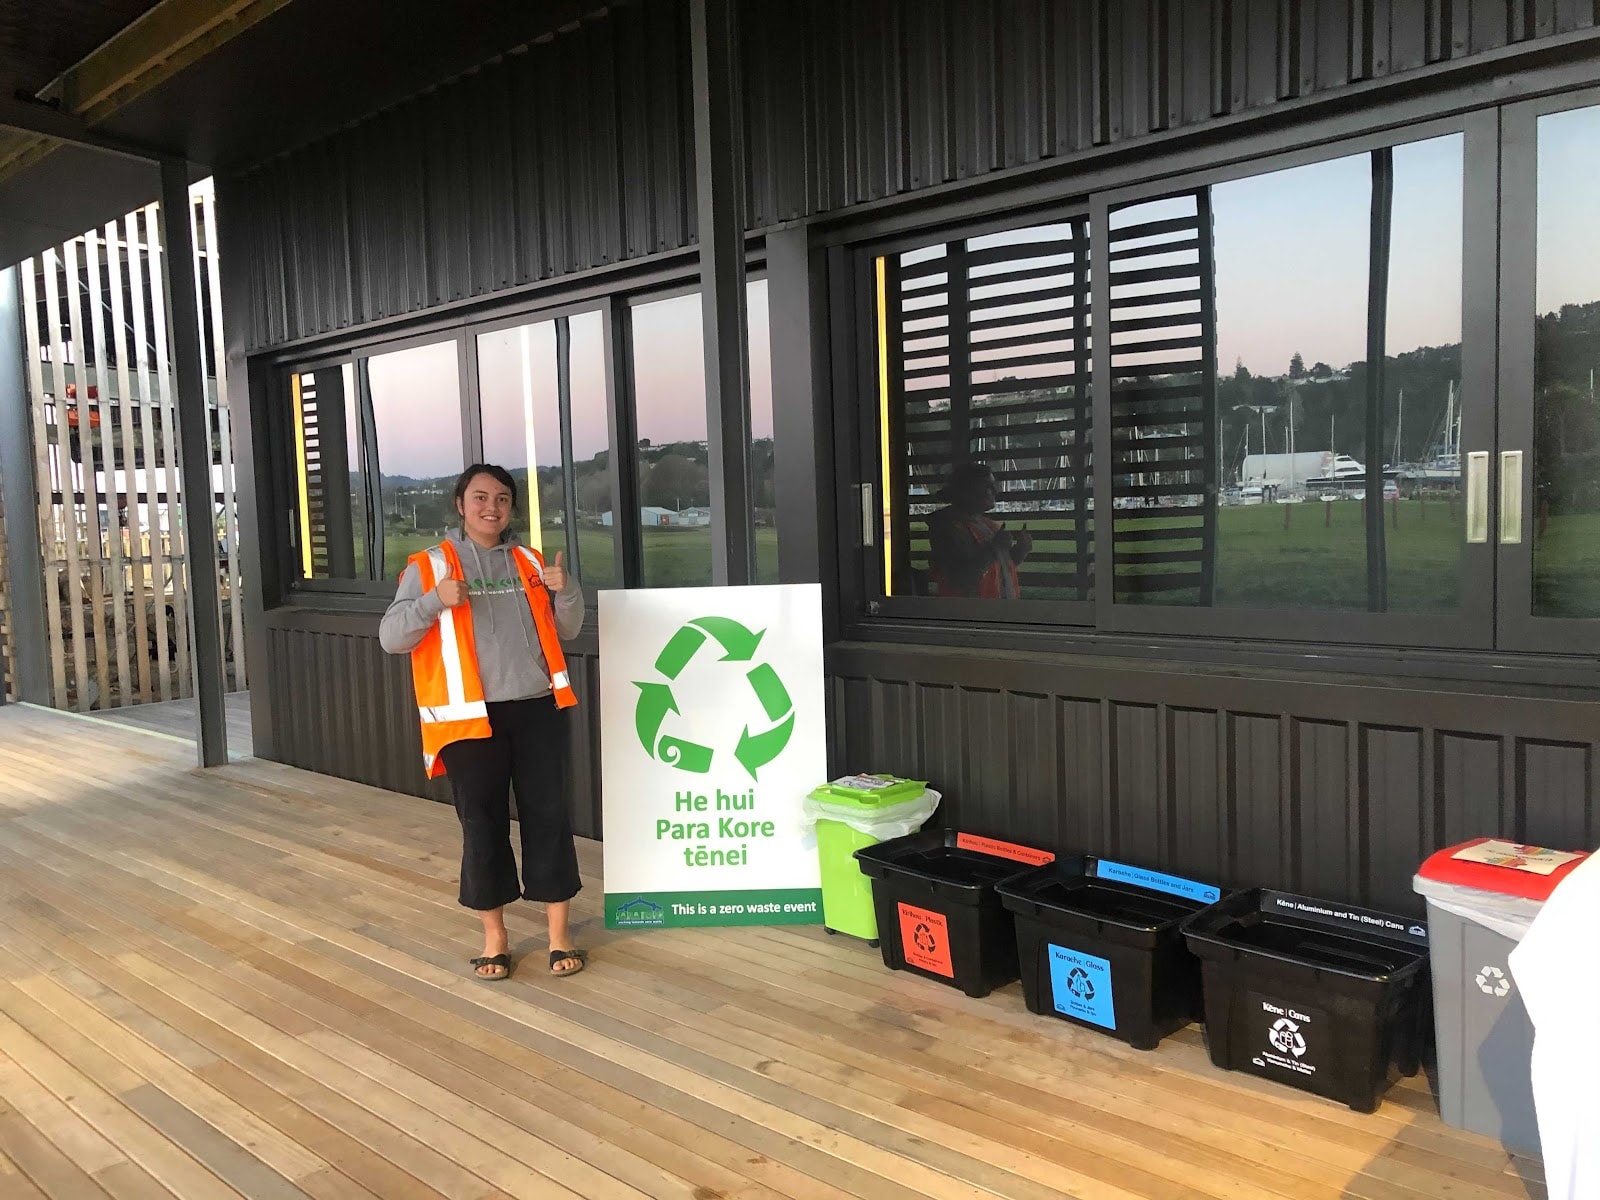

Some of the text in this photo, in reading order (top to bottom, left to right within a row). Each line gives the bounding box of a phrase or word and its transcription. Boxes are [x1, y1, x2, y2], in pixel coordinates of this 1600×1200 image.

[675, 788, 754, 812] He hui
[656, 817, 775, 840] Para Kore
[683, 844, 747, 867] tēnei
[1133, 873, 1149, 882] Glass
[1150, 876, 1170, 887] Bottles
[1170, 882, 1182, 890] and
[1182, 884, 1194, 893] Jars
[671, 901, 817, 915] This is a zero waste event
[1297, 903, 1333, 916] Aluminium
[1334, 910, 1347, 919] and
[1347, 912, 1360, 921] Tin
[1360, 915, 1384, 928] (Steel)
[1385, 920, 1404, 931] Cans
[1086, 960, 1105, 972] Glass
[1288, 1009, 1311, 1023] Cans
